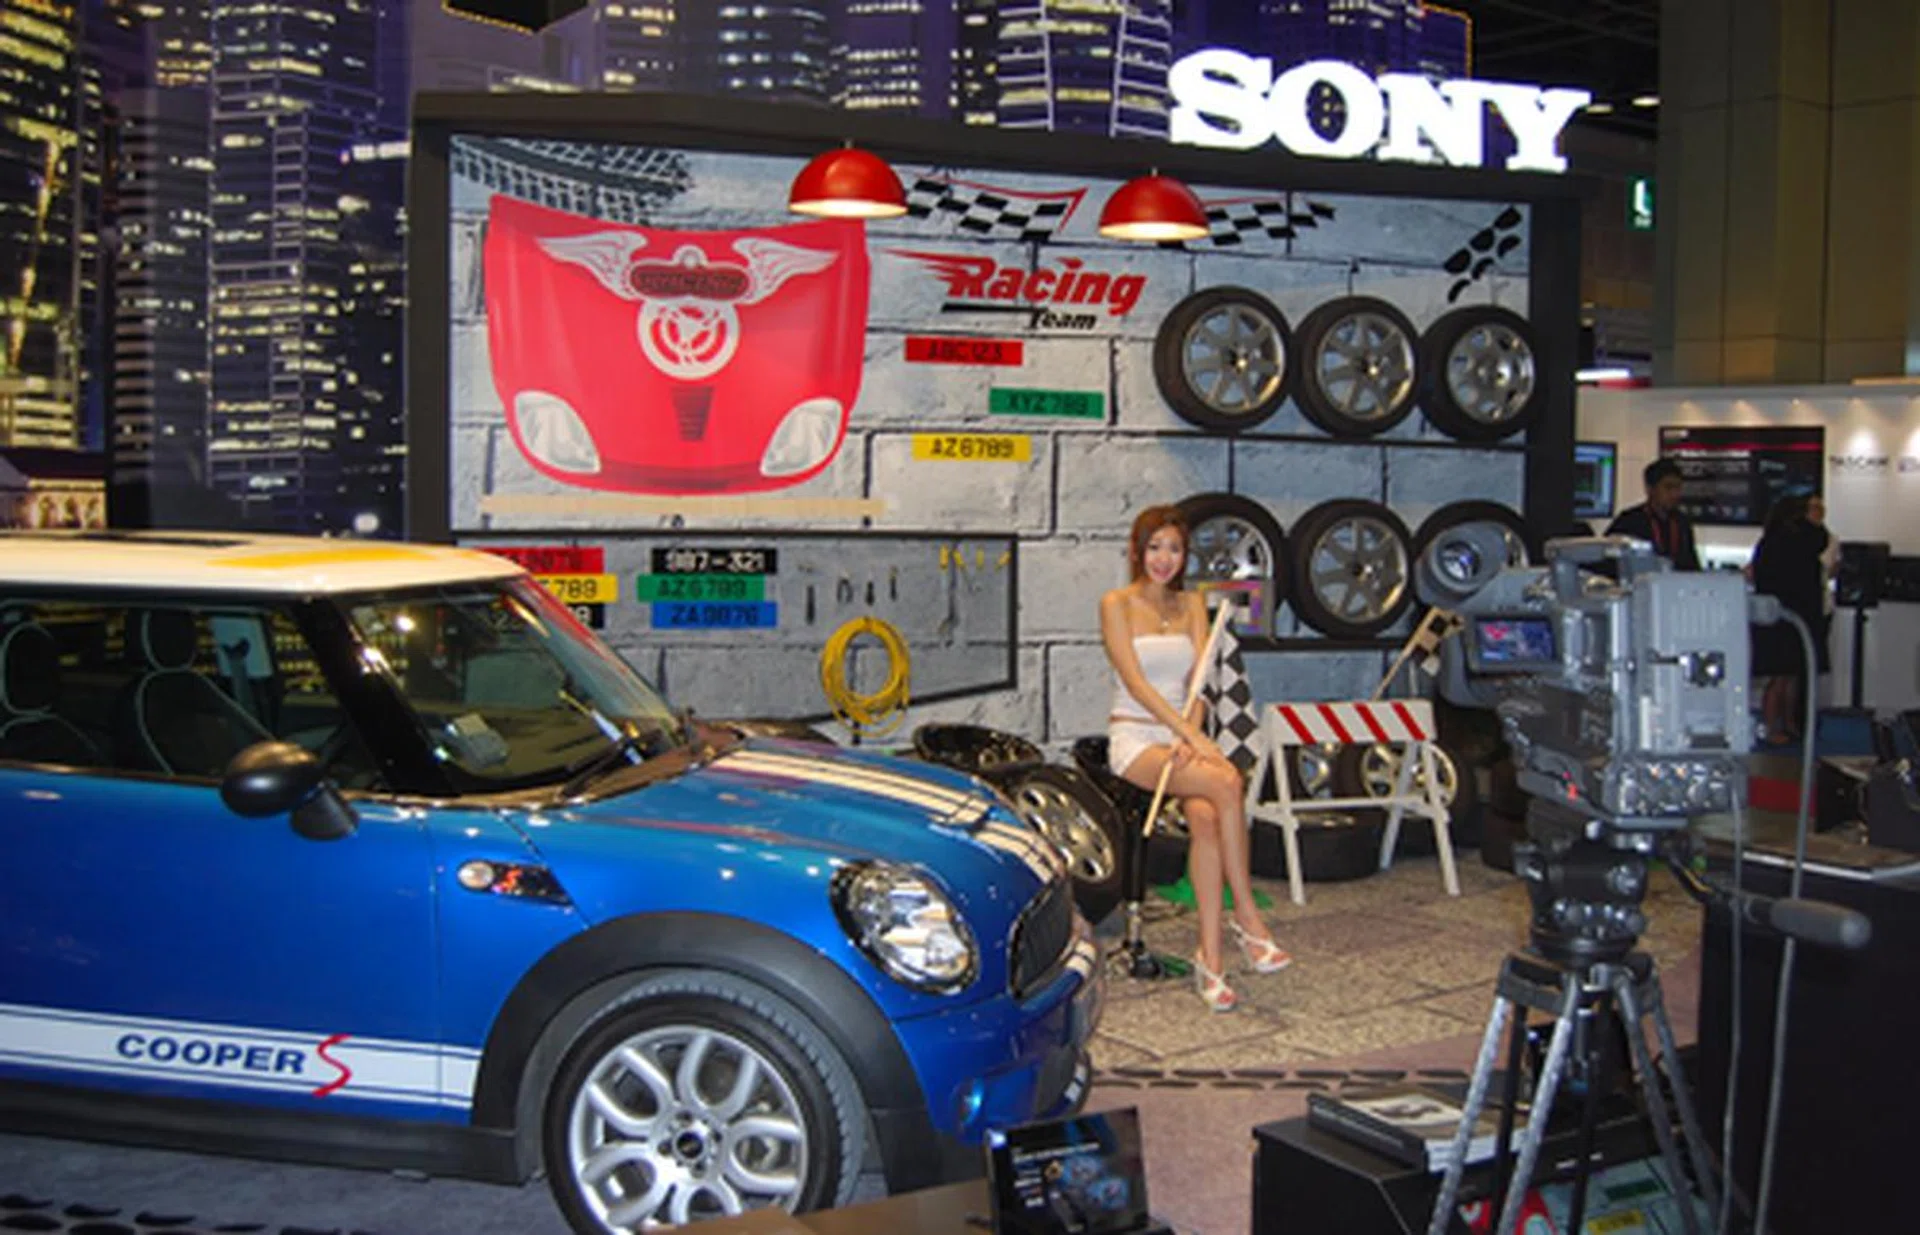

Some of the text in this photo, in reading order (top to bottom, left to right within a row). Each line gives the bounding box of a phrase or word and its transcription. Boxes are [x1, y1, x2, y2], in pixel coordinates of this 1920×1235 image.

[1167, 48, 1591, 173] SONY
[884, 249, 1146, 316] Racing
[1025, 310, 1097, 329] Team
[931, 438, 1014, 458] AZ6789
[116, 1033, 353, 1097] COOPER S
